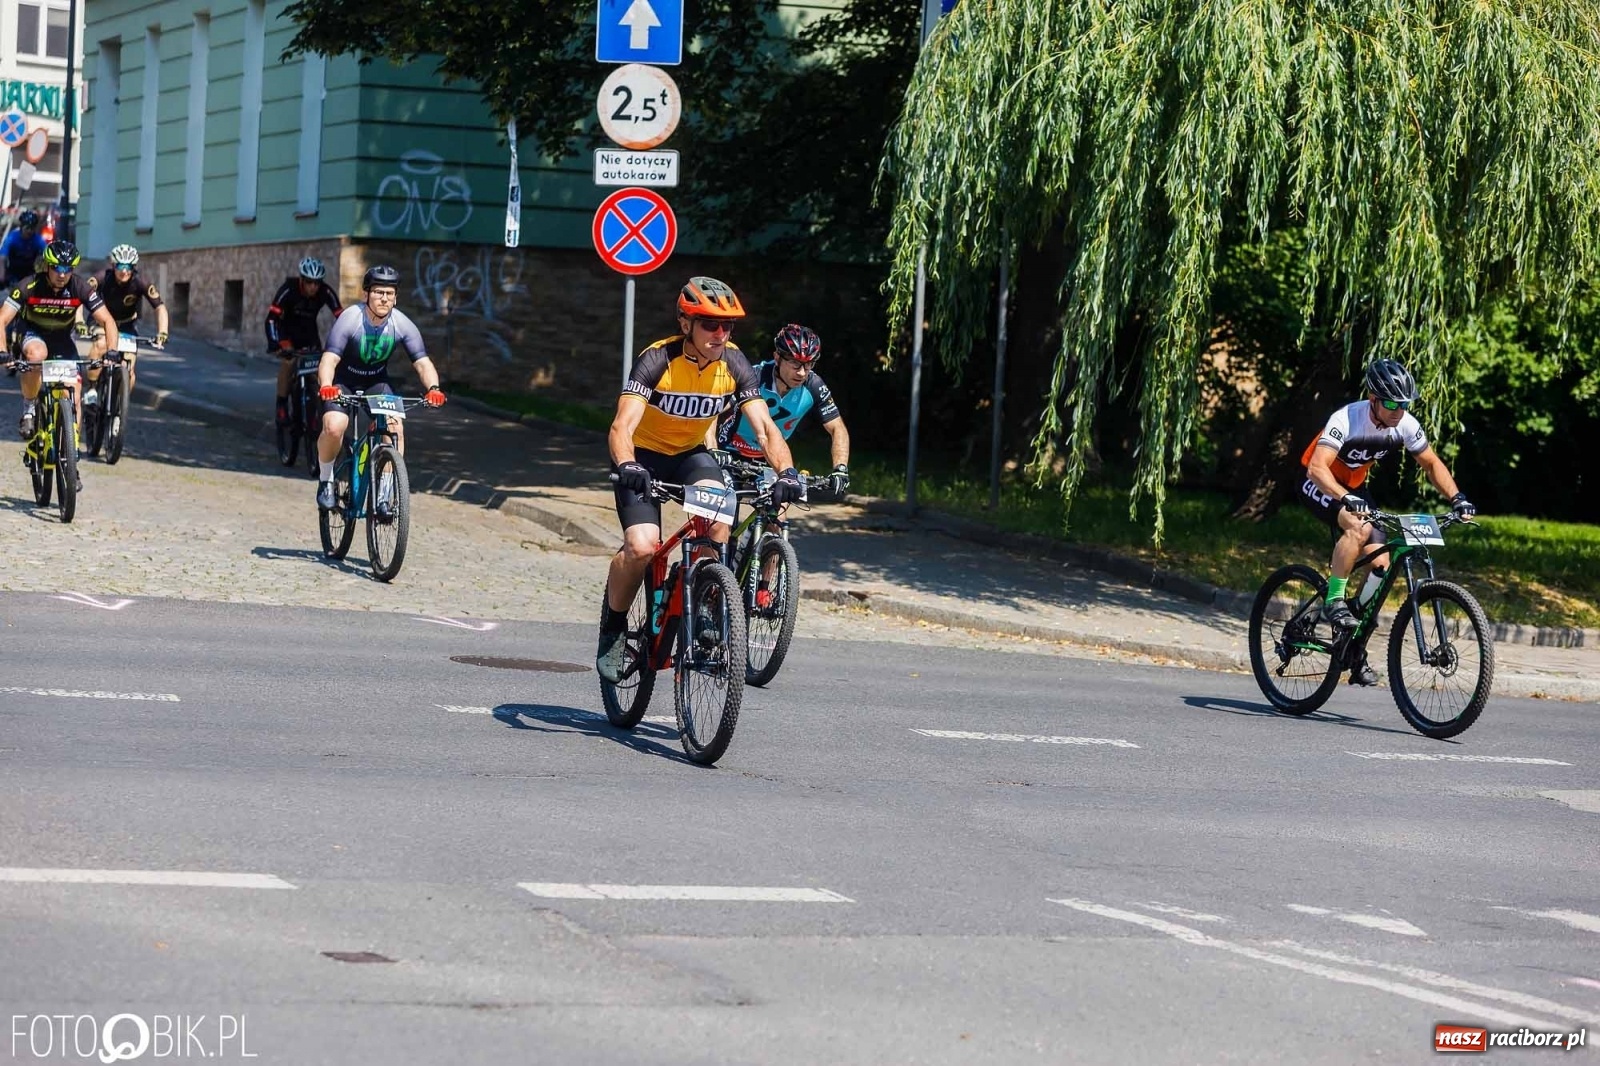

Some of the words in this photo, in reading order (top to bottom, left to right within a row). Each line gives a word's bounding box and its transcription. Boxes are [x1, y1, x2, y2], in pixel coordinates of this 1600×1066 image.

[601, 154, 621, 165] Nie
[626, 155, 672, 168] dotyczy
[602, 169, 667, 181] autokarów
[659, 395, 725, 417] NODON
[695, 490, 727, 508] 1975
[1410, 524, 1434, 535] 1160
